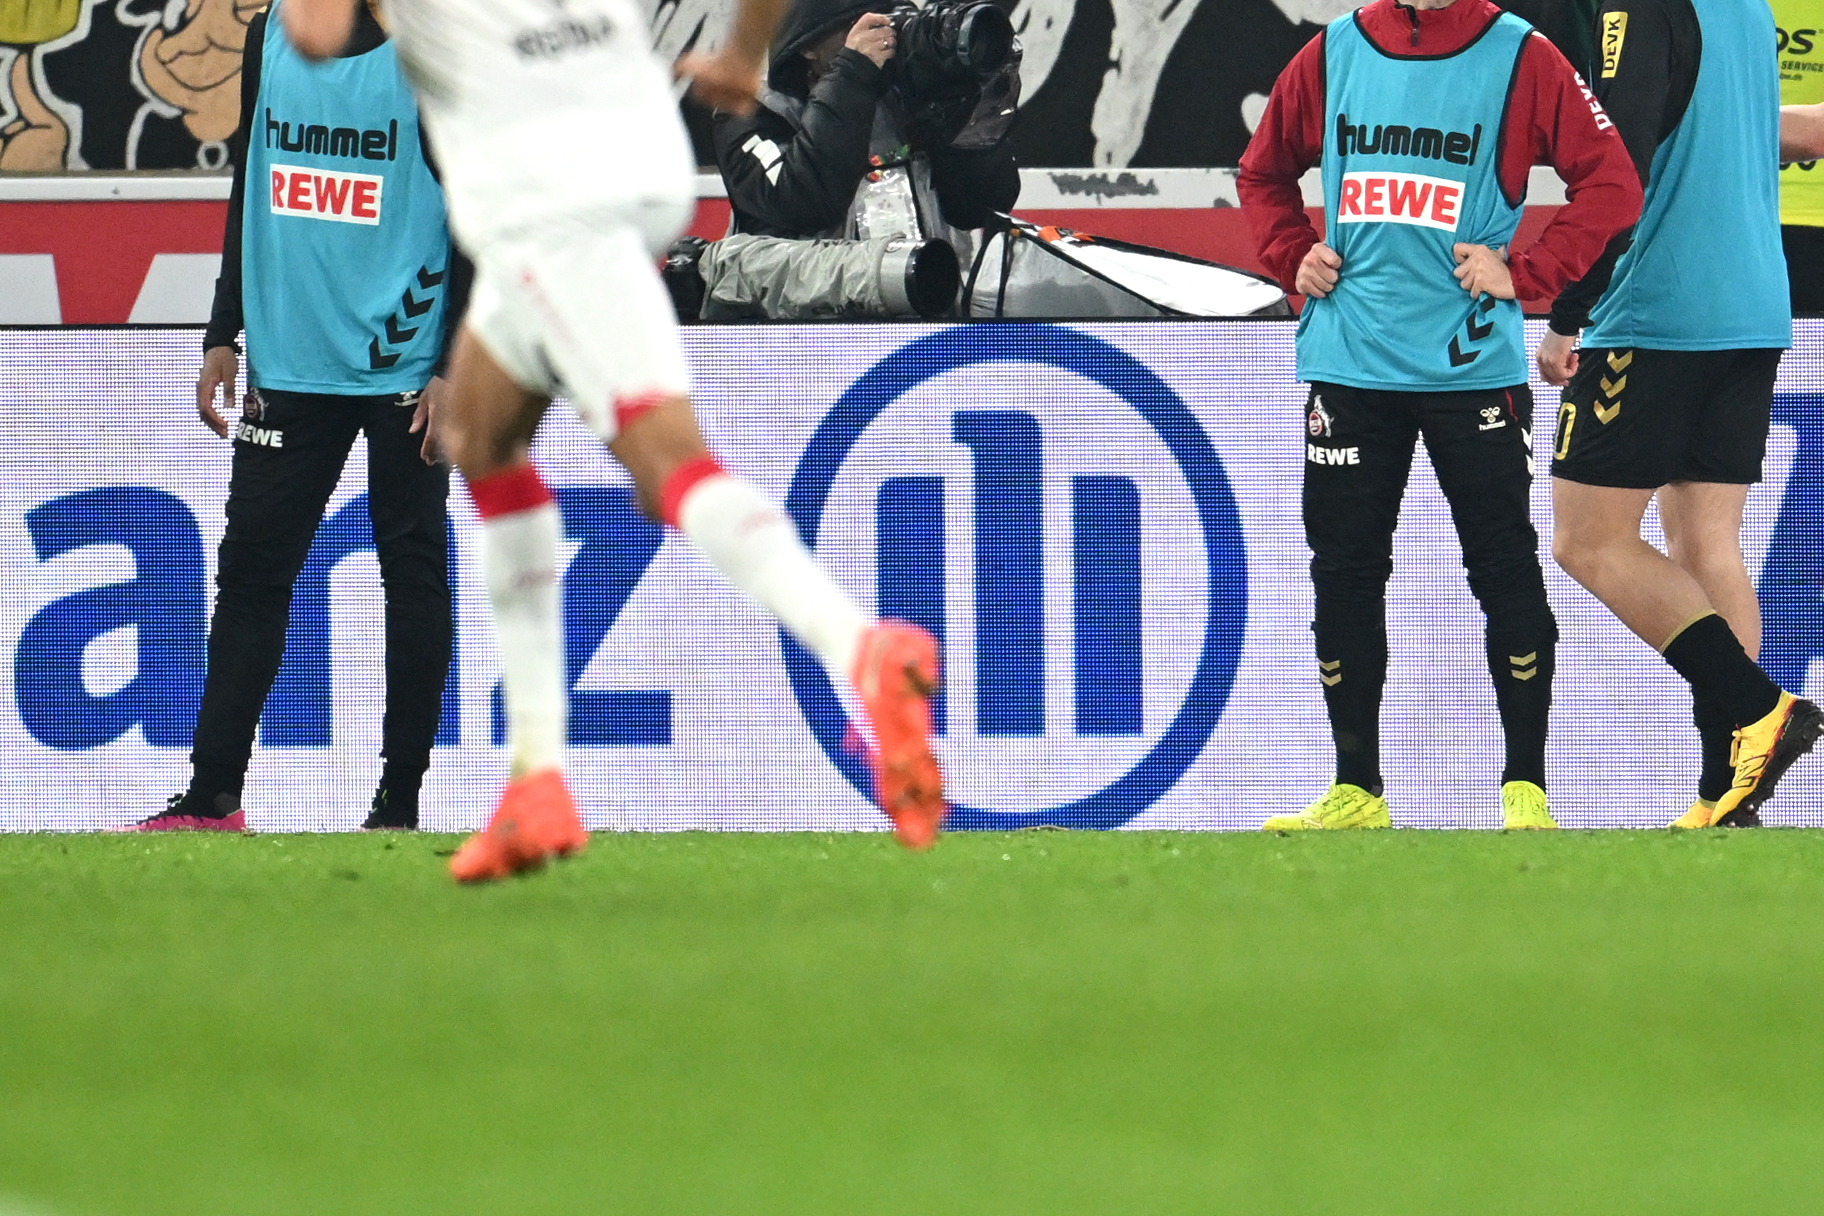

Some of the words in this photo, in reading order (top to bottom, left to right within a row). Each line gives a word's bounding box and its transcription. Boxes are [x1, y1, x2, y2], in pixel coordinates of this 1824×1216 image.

[1603, 18, 1621, 71] DEVK
[266, 107, 398, 162] hummel
[1336, 113, 1483, 167] hummel
[271, 170, 378, 219] REWE
[1339, 178, 1460, 226] REWE
[1307, 443, 1361, 466] REWE
